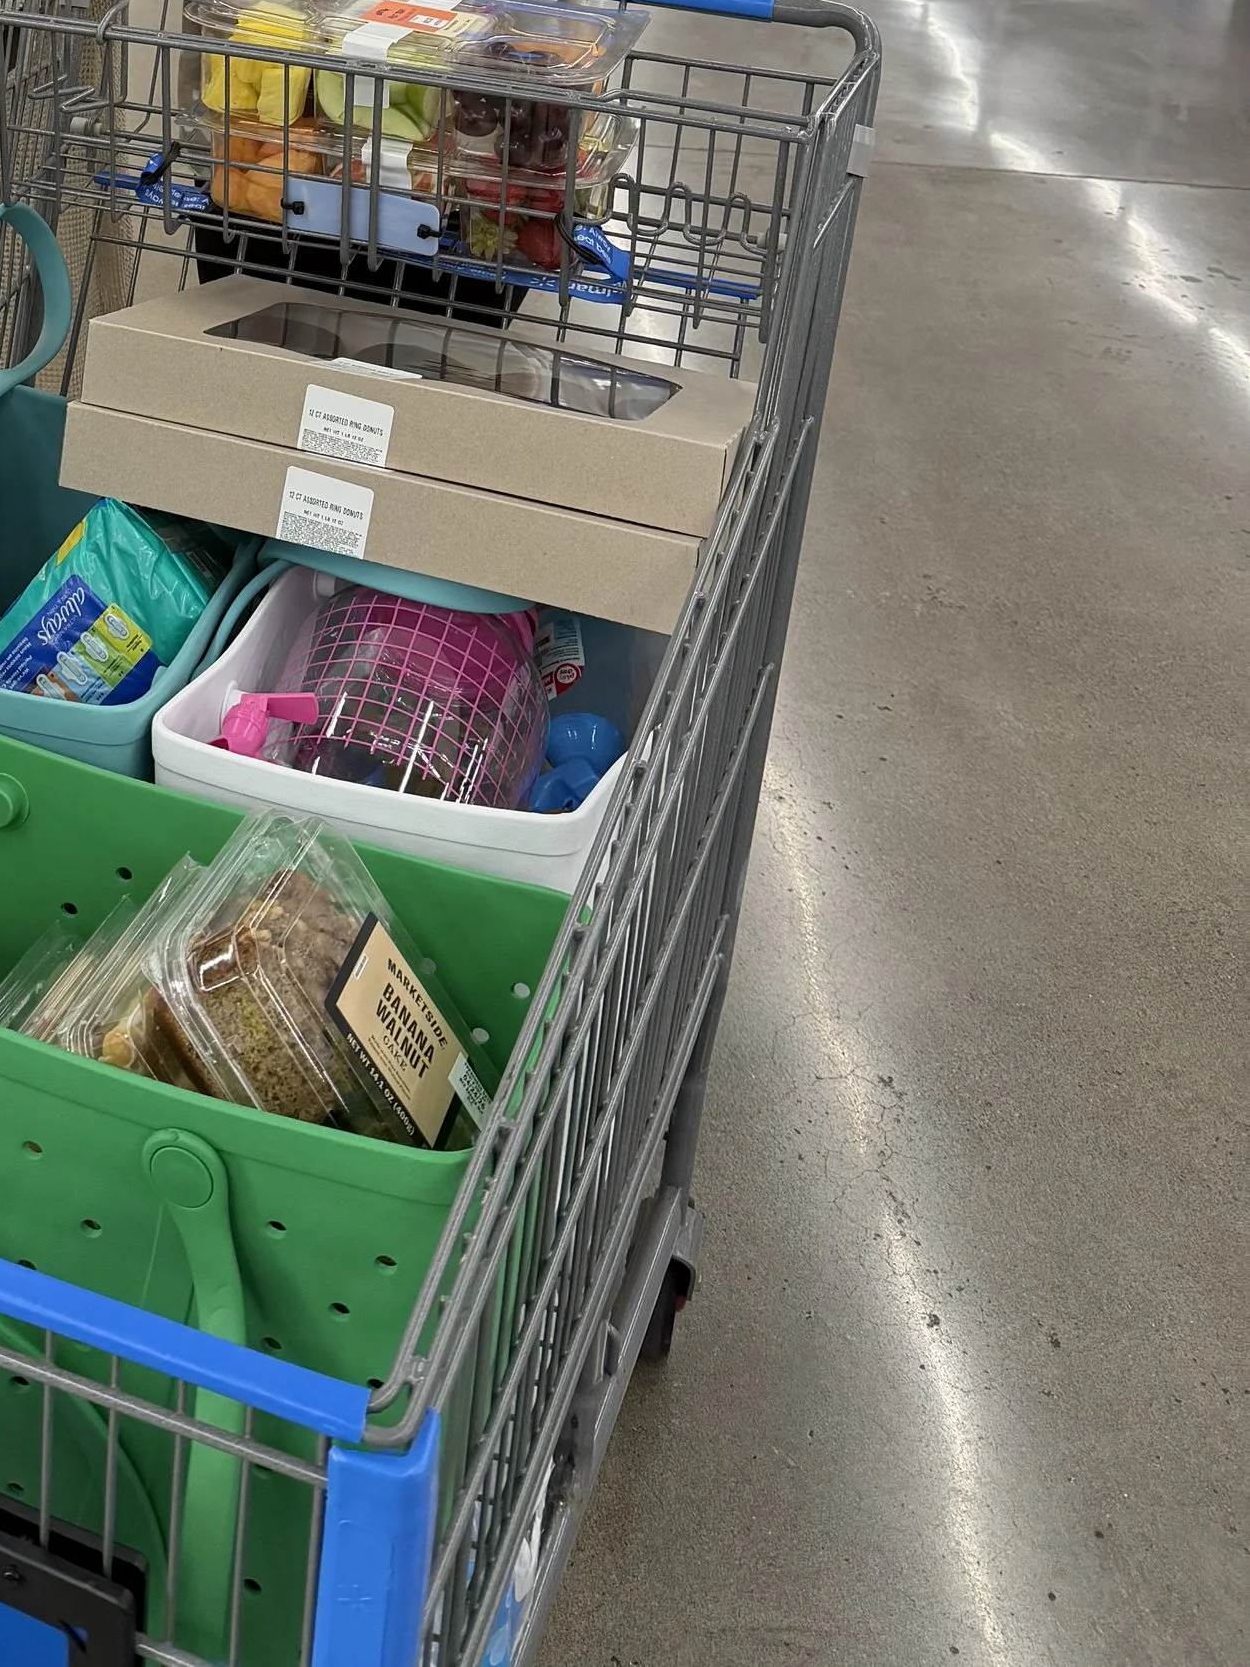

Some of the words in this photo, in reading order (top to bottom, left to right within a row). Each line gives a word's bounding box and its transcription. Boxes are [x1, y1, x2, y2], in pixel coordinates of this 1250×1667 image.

[322, 413, 348, 427] ASSORTED
[362, 422, 383, 437] DONUTS
[303, 494, 328, 509] ASSORTED
[330, 501, 342, 513] RING
[343, 505, 363, 520] DONUTS
[38, 587, 86, 646] always
[382, 982, 435, 1064] BANANA
[387, 958, 448, 1048] MARKETSIDE
[344, 1032, 362, 1053] NET
[356, 1050, 372, 1068] WT
[376, 999, 429, 1079] WALNUT
[382, 1035, 408, 1072] CAKE
